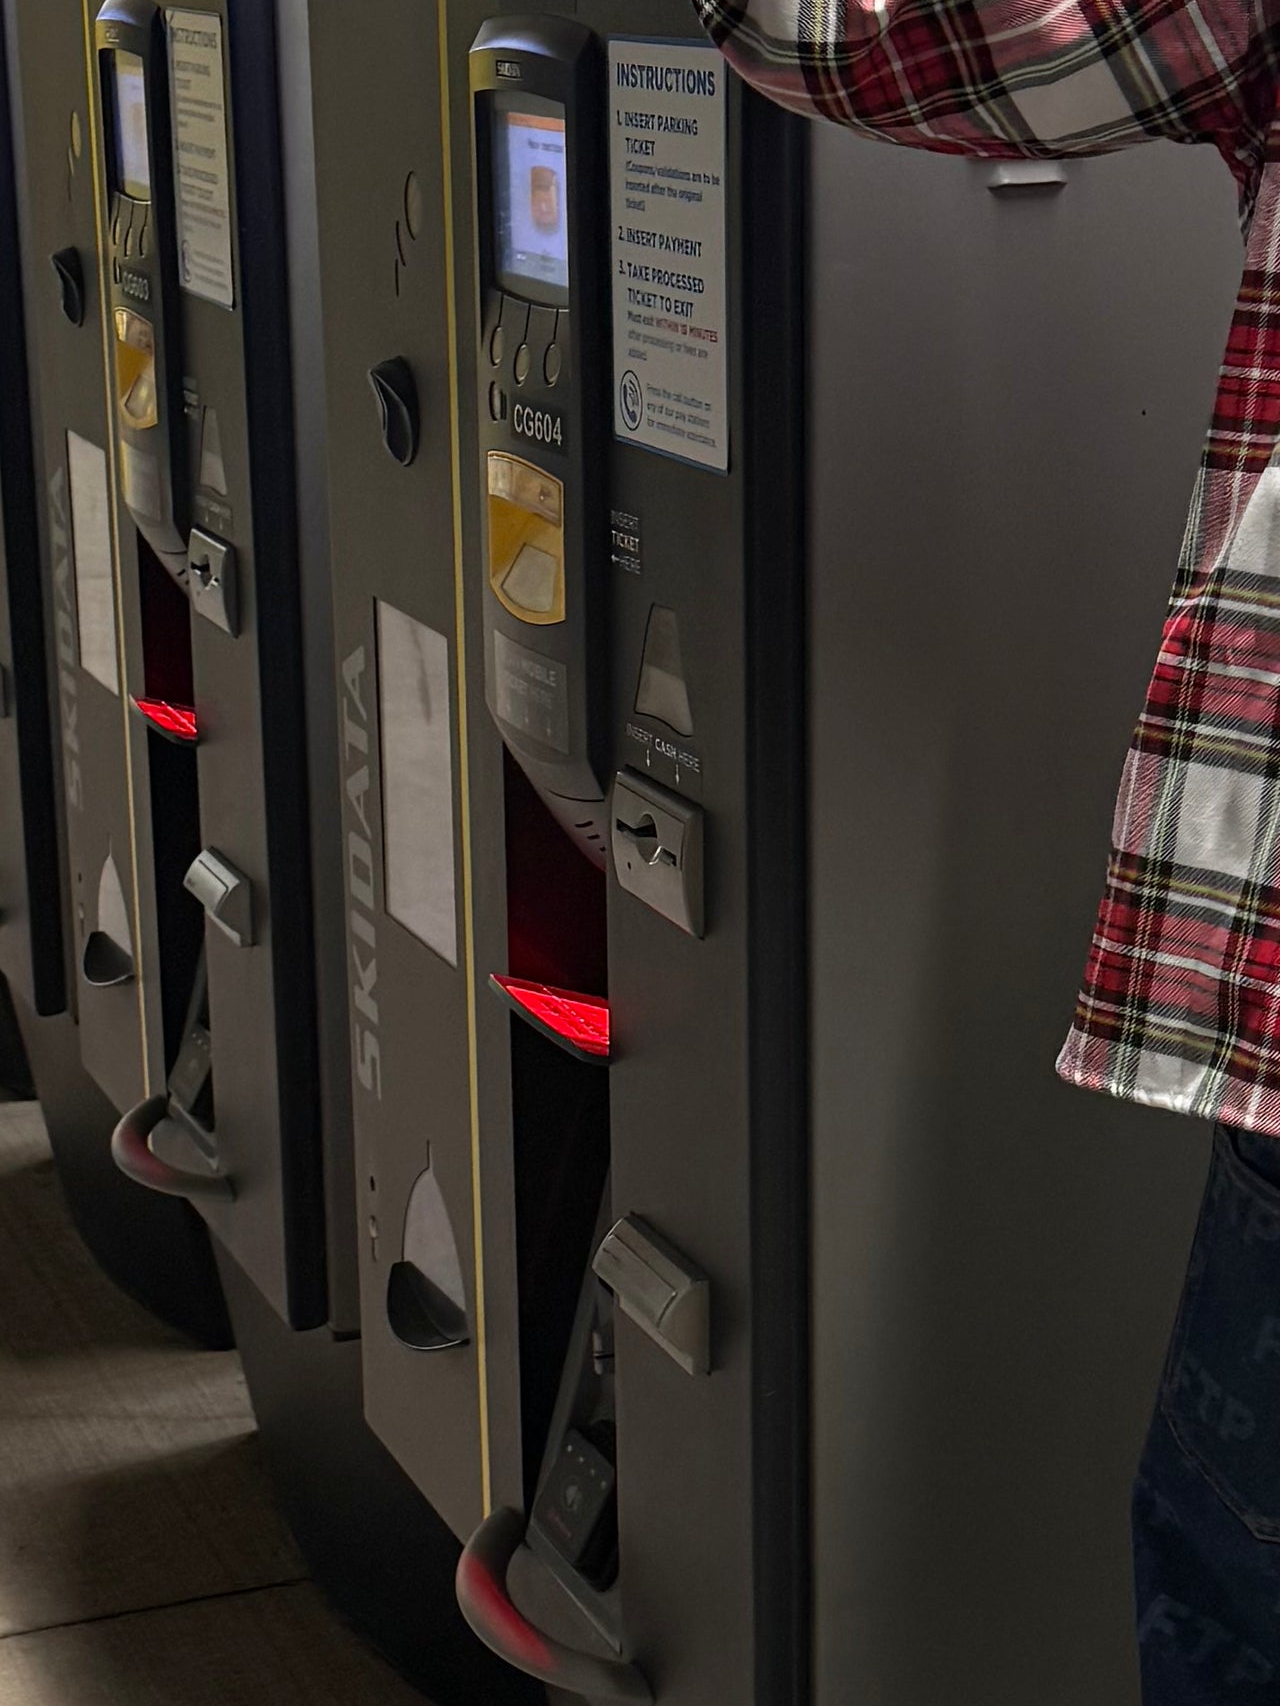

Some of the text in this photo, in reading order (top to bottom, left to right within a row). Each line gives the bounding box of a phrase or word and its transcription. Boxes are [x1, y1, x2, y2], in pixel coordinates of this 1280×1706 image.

[617, 62, 716, 96] INSTRUCTIONS
[624, 111, 656, 131] INSERT
[657, 114, 698, 136] PARKING
[625, 137, 655, 156] TICKET
[618, 226, 702, 257] 2. INSERT PAYMENT
[618, 260, 705, 294] 3. TAKE PROCESSED
[627, 288, 694, 319] TICKET TO EXIT
[514, 404, 562, 445] CG604
[611, 530, 640, 552] TICKET
[654, 738, 677, 760] CASH
[341, 644, 382, 1102] SKIDATA
